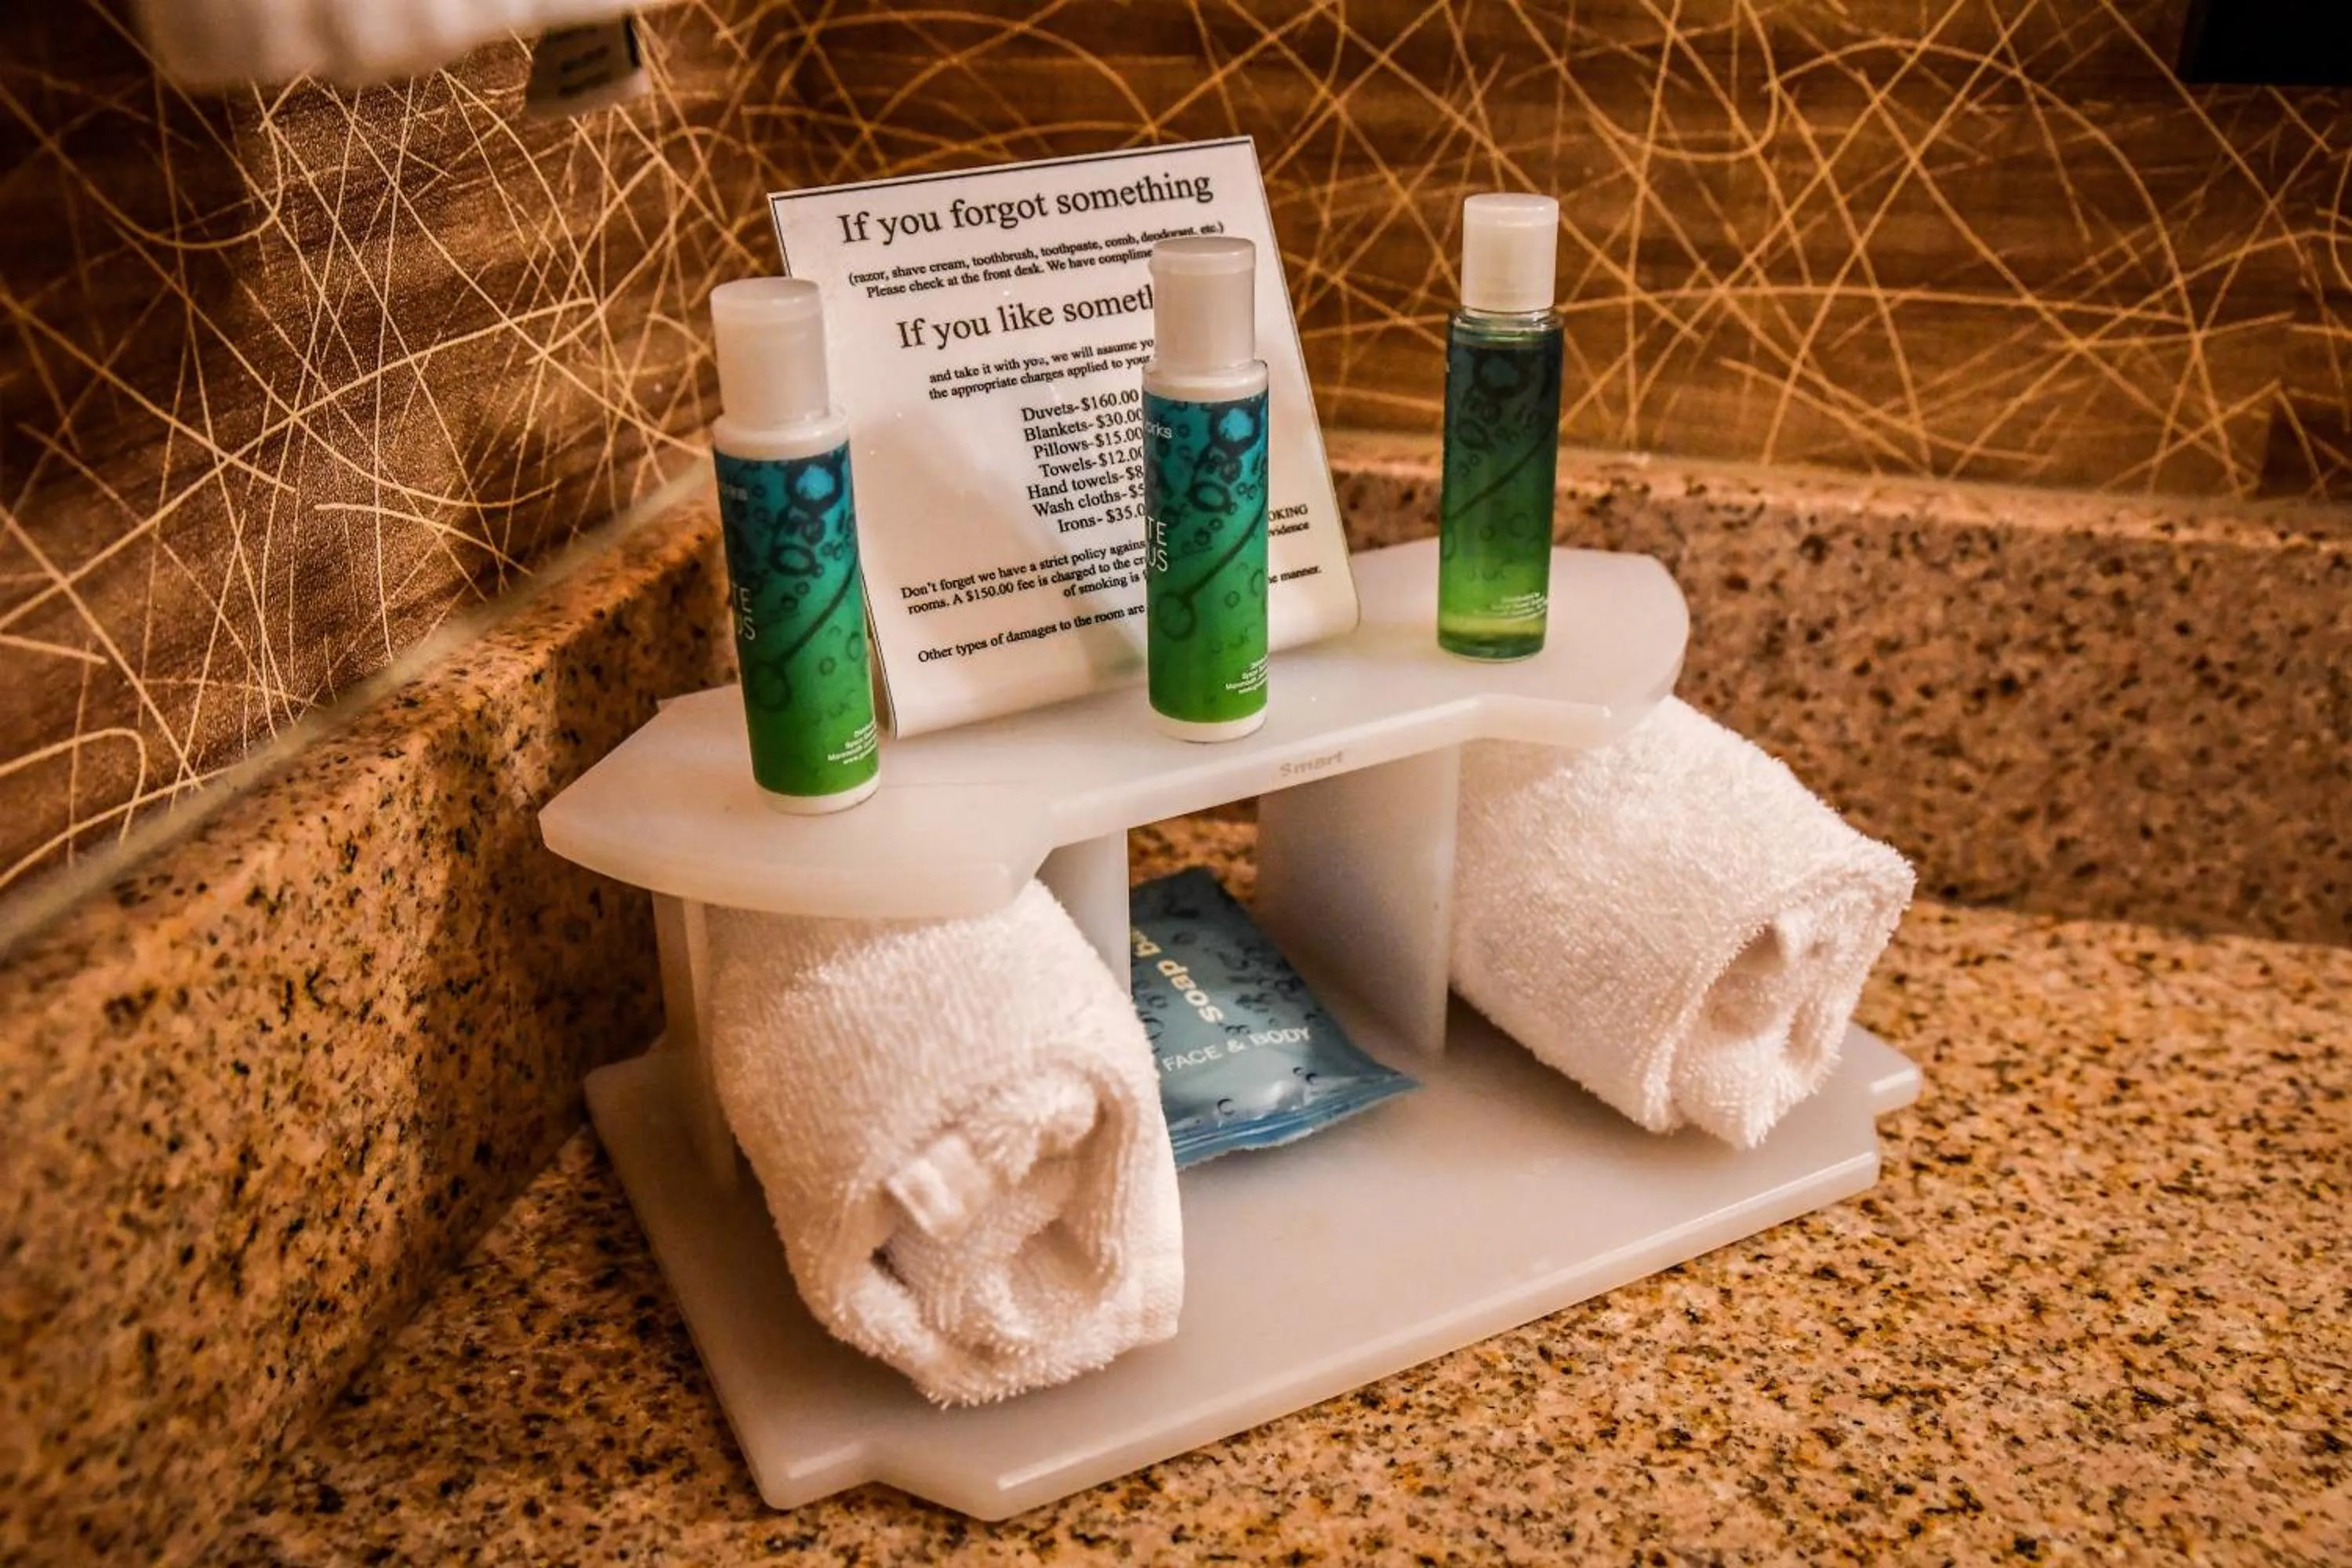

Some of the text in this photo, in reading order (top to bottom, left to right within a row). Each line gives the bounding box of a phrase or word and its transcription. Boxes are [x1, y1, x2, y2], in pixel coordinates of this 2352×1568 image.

[837, 172, 1214, 245] If you forgot something
[848, 271, 889, 286] (razor,
[891, 265, 927, 278] shave
[929, 260, 970, 273] cream,
[972, 248, 1039, 266] toothbrush,
[1040, 239, 1102, 256] toothpaste,
[1105, 232, 1140, 249] comb,
[866, 248, 1153, 298] Please check at the front desk. We have complime
[895, 317, 926, 349] If
[931, 317, 992, 350] you
[996, 302, 1054, 333] like
[928, 387, 948, 400] the
[951, 377, 1018, 398] appropriate
[1020, 370, 1064, 384] charges
[1067, 359, 1109, 379] applied
[1111, 359, 1123, 368] to
[929, 368, 952, 383] and
[953, 365, 979, 379] take
[982, 363, 992, 376] it
[993, 358, 1021, 372] with
[1051, 352, 1069, 363] we
[1071, 346, 1094, 360] will
[1095, 341, 1138, 356] assume
[1139, 339, 1154, 351] yo
[1026, 479, 1068, 500] Hand
[1032, 499, 1074, 517] Wash
[900, 503, 1308, 600] Don't forget we have a strict policy agains OKING
[907, 598, 950, 615] rooms.
[953, 593, 964, 605] A
[966, 582, 1014, 602] $150.00
[1017, 579, 1036, 591] fee
[1038, 575, 1048, 587] is
[1051, 566, 1097, 584] charged
[1098, 563, 1110, 573] to
[1113, 558, 1131, 570] the
[1268, 521, 1310, 536] vidence
[1063, 583, 1077, 597] of
[1079, 576, 1128, 595] smoking
[1131, 572, 1141, 583] is
[918, 646, 953, 662] Other
[956, 639, 988, 656] types
[990, 632, 1004, 647] of
[1006, 623, 1058, 643] damages
[1059, 619, 1072, 630] to
[1074, 615, 1092, 627] the
[1094, 609, 1125, 623] room
[1127, 604, 1145, 616] are
[1156, 959, 1225, 1024] soap
[1162, 1027, 1311, 1072] FACE & BODY
